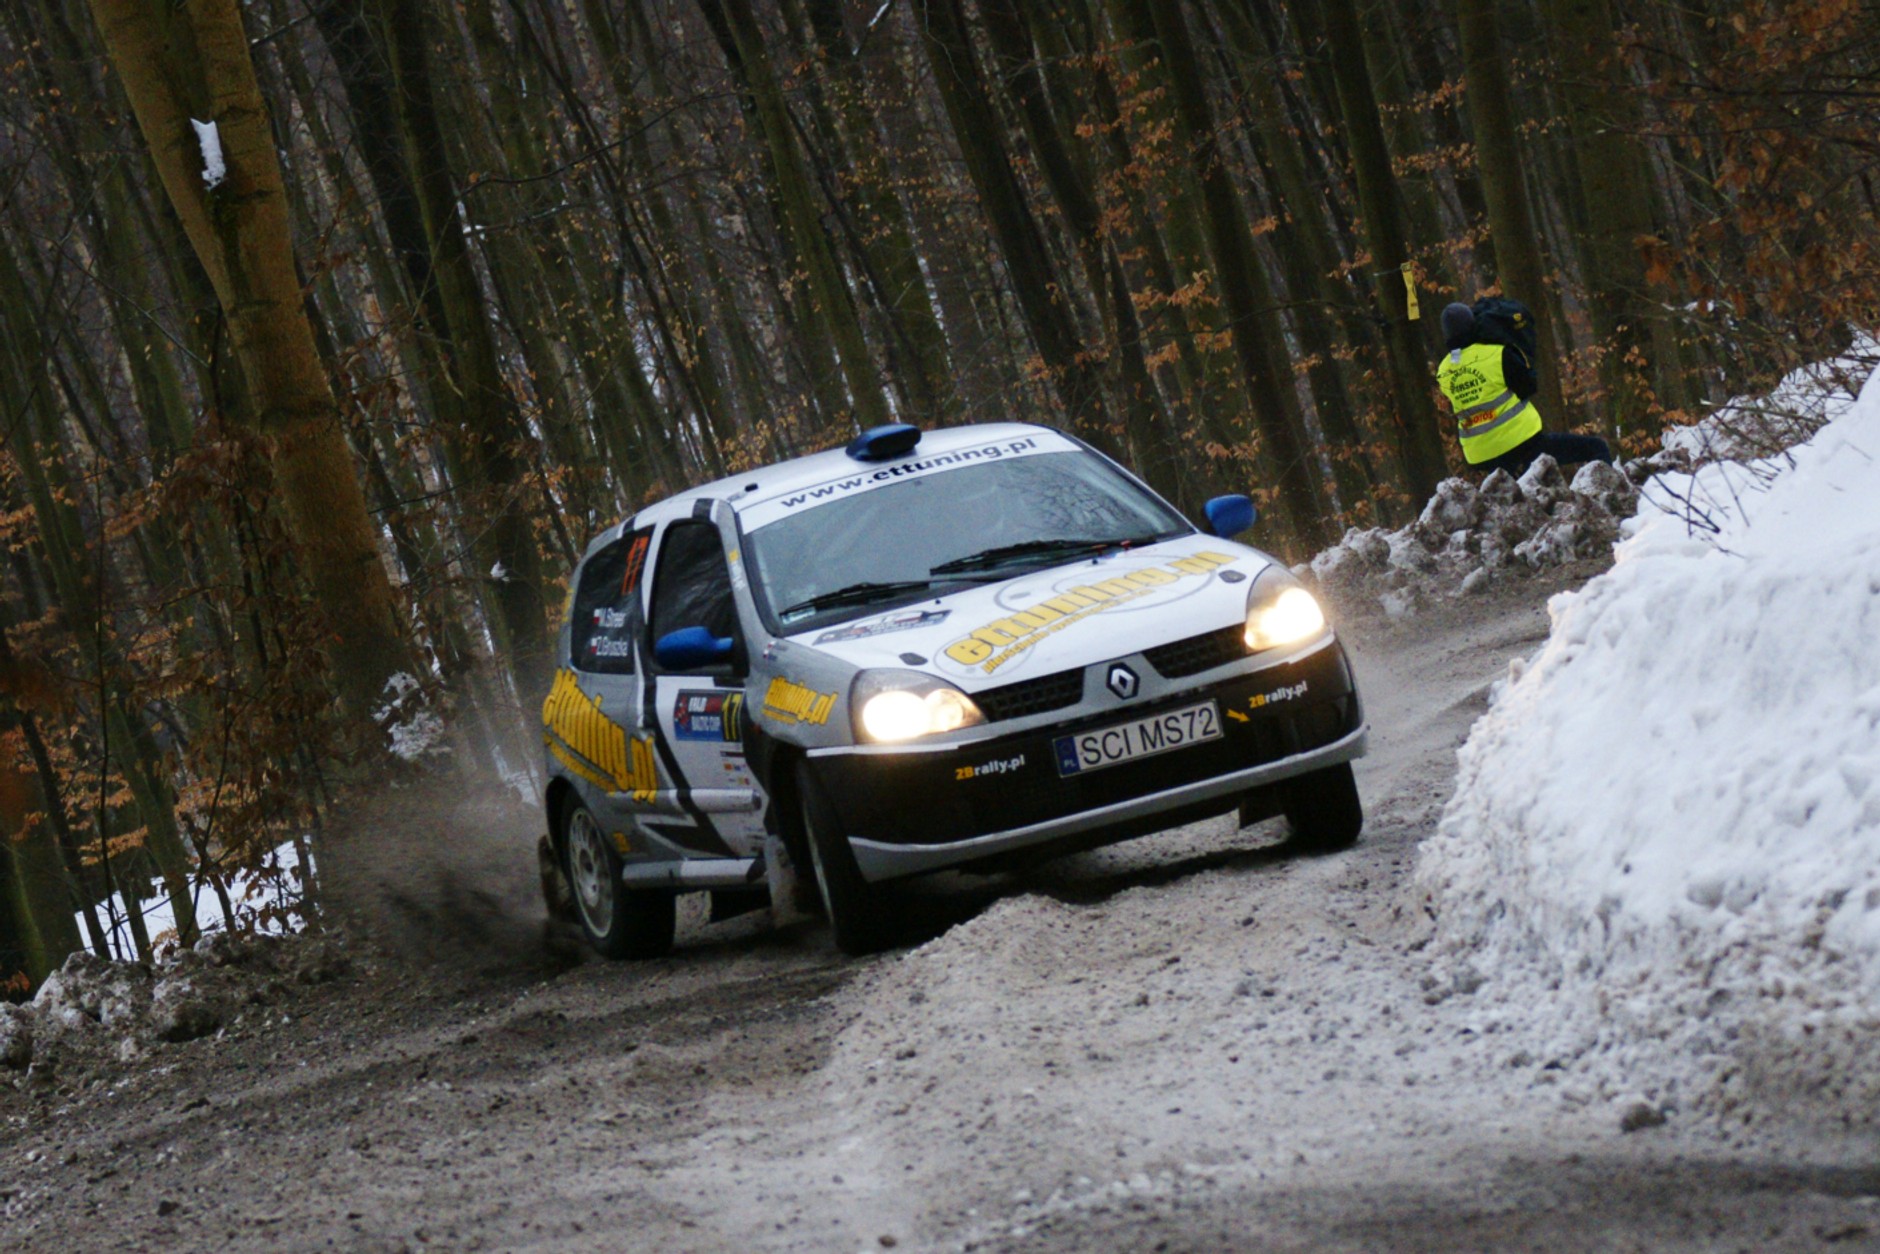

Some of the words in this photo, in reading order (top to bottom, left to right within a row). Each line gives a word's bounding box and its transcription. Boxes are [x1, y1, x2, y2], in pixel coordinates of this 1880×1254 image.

[781, 438, 1035, 508] www.ettuning.pl
[944, 550, 1238, 666] ettuning.pl
[722, 692, 742, 741] 17
[1248, 681, 1309, 710] 2Brally.pl
[1080, 734, 1133, 767] SCI
[1138, 706, 1219, 752] MS72
[955, 754, 1026, 782] 2Brally.pl
[1064, 758, 1077, 768] PL
